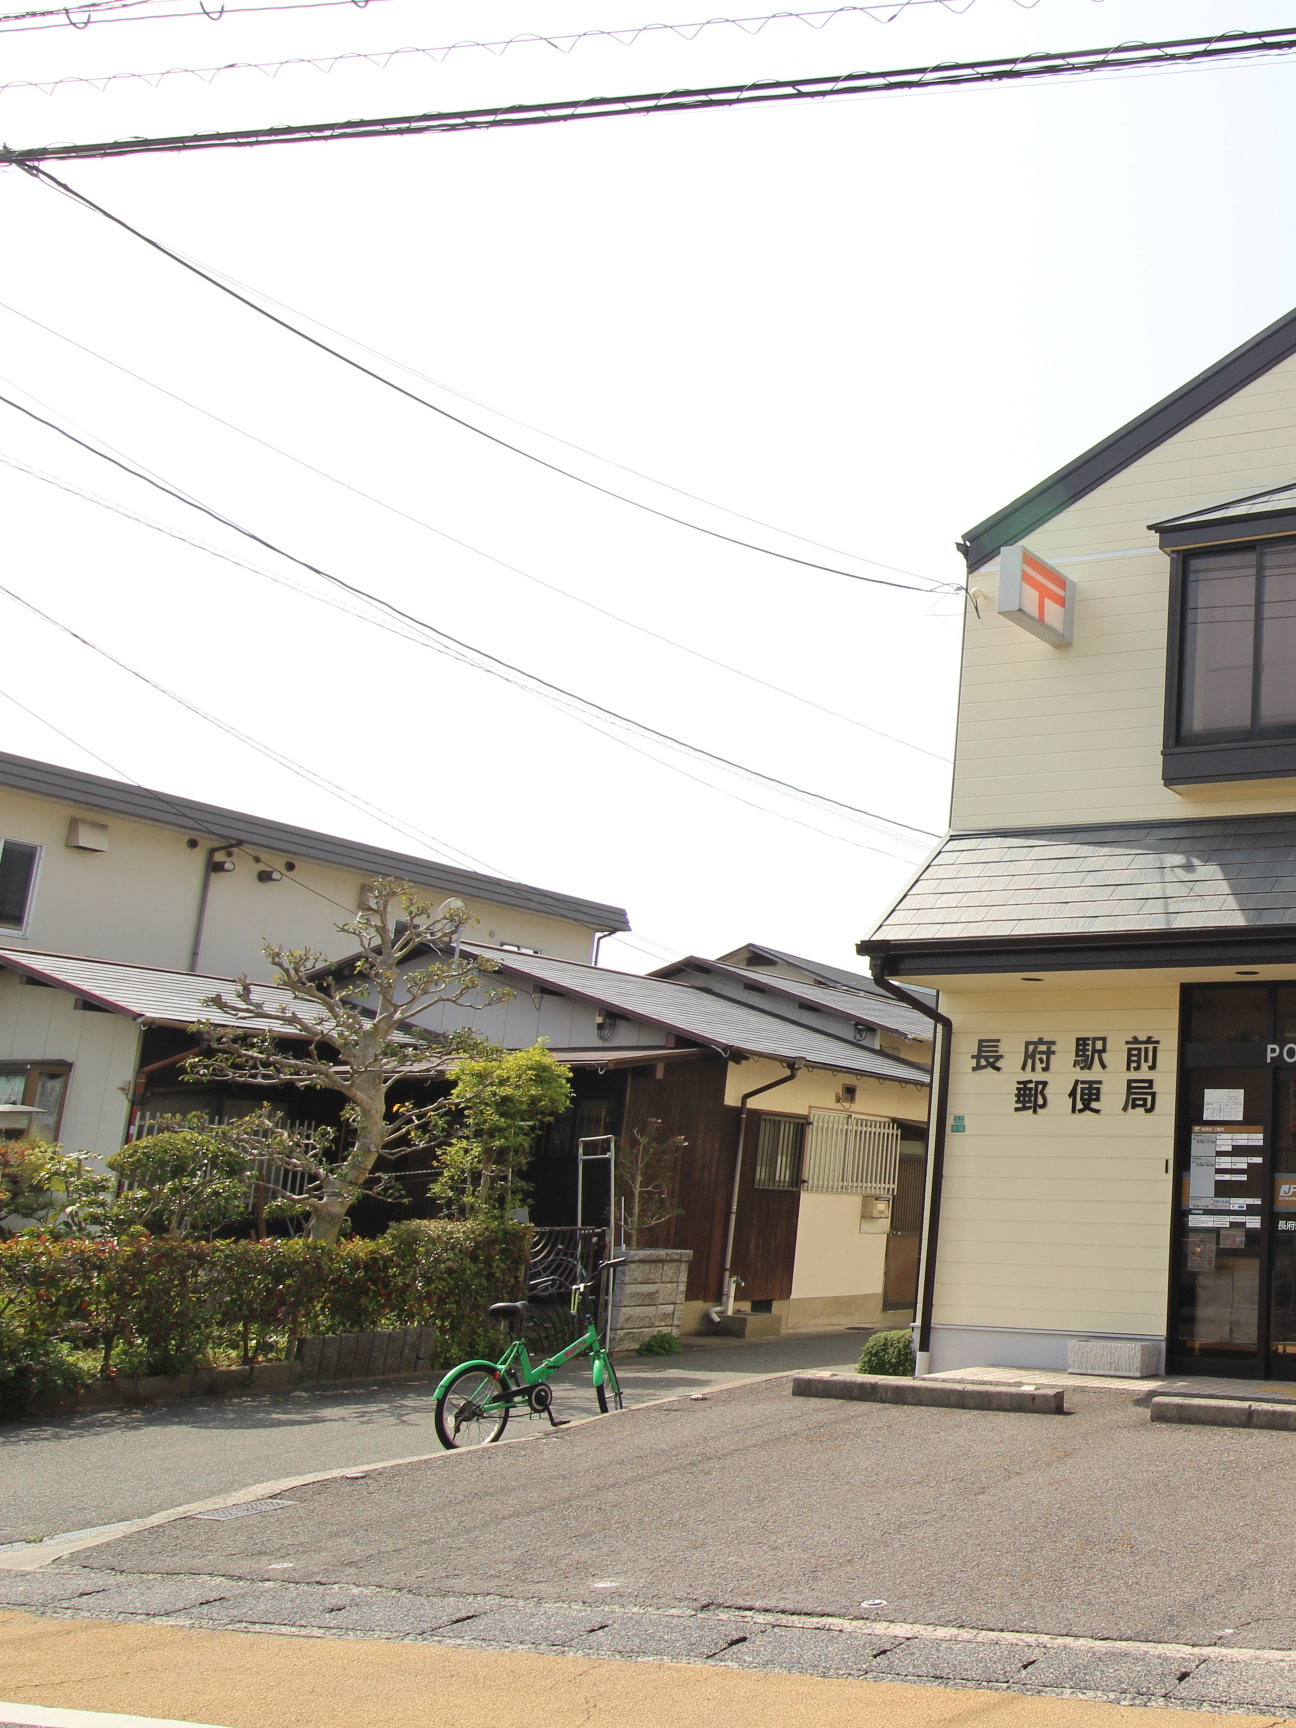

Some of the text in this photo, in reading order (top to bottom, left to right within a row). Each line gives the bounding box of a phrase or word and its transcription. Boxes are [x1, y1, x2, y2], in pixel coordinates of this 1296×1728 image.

[970, 1036, 1161, 1073] 長府駅前
[1014, 1078, 1158, 1115] 郵便局
